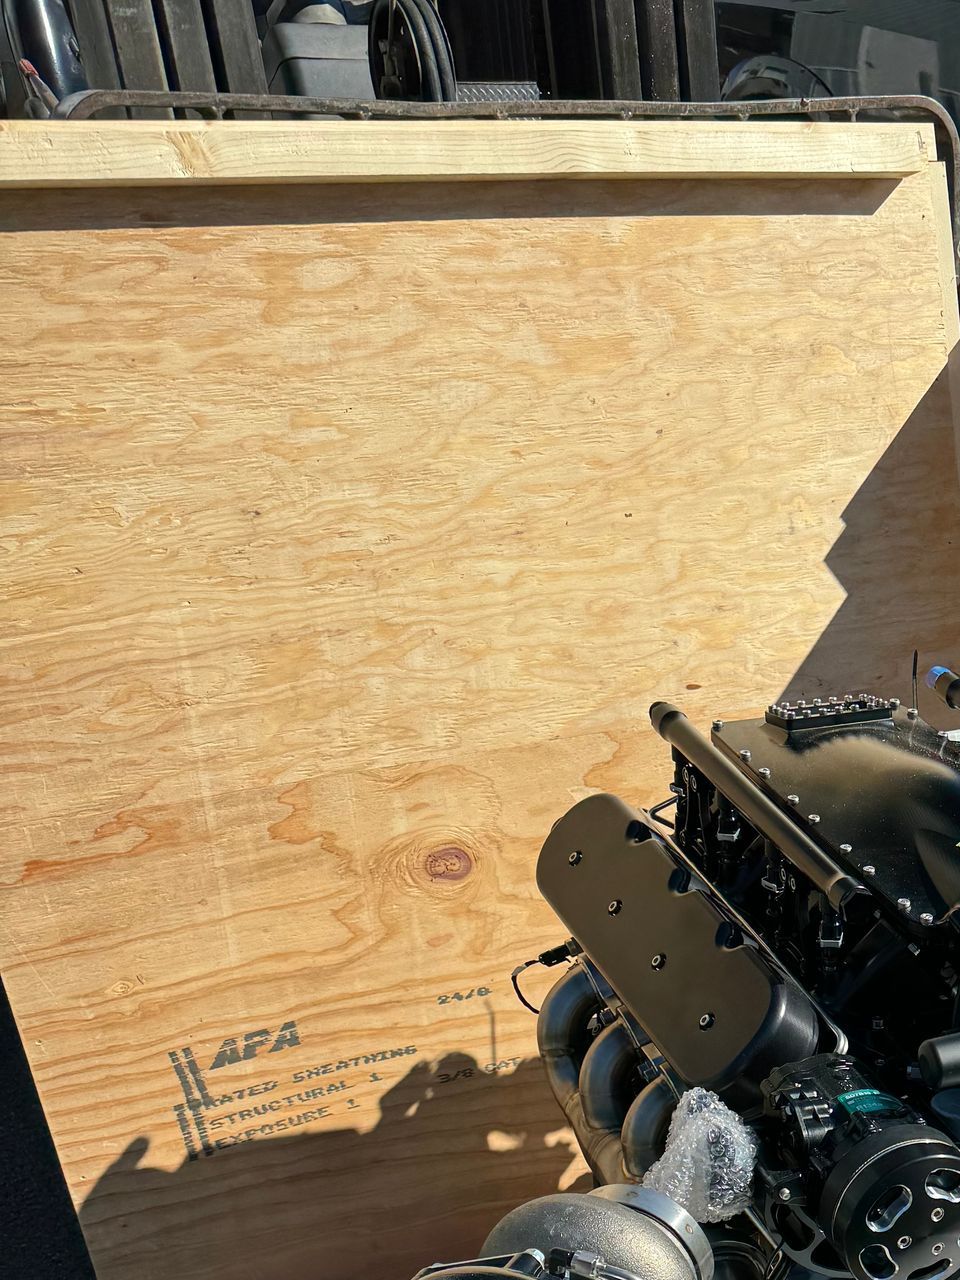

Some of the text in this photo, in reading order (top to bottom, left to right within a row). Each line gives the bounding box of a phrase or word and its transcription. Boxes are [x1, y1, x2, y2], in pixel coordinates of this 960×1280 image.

[208, 1020, 301, 1071] APA
[292, 1044, 418, 1084] SHEATHING
[208, 1072, 384, 1131] STRUCTURAL 1
[214, 1098, 361, 1151] EXPOSURE 1
